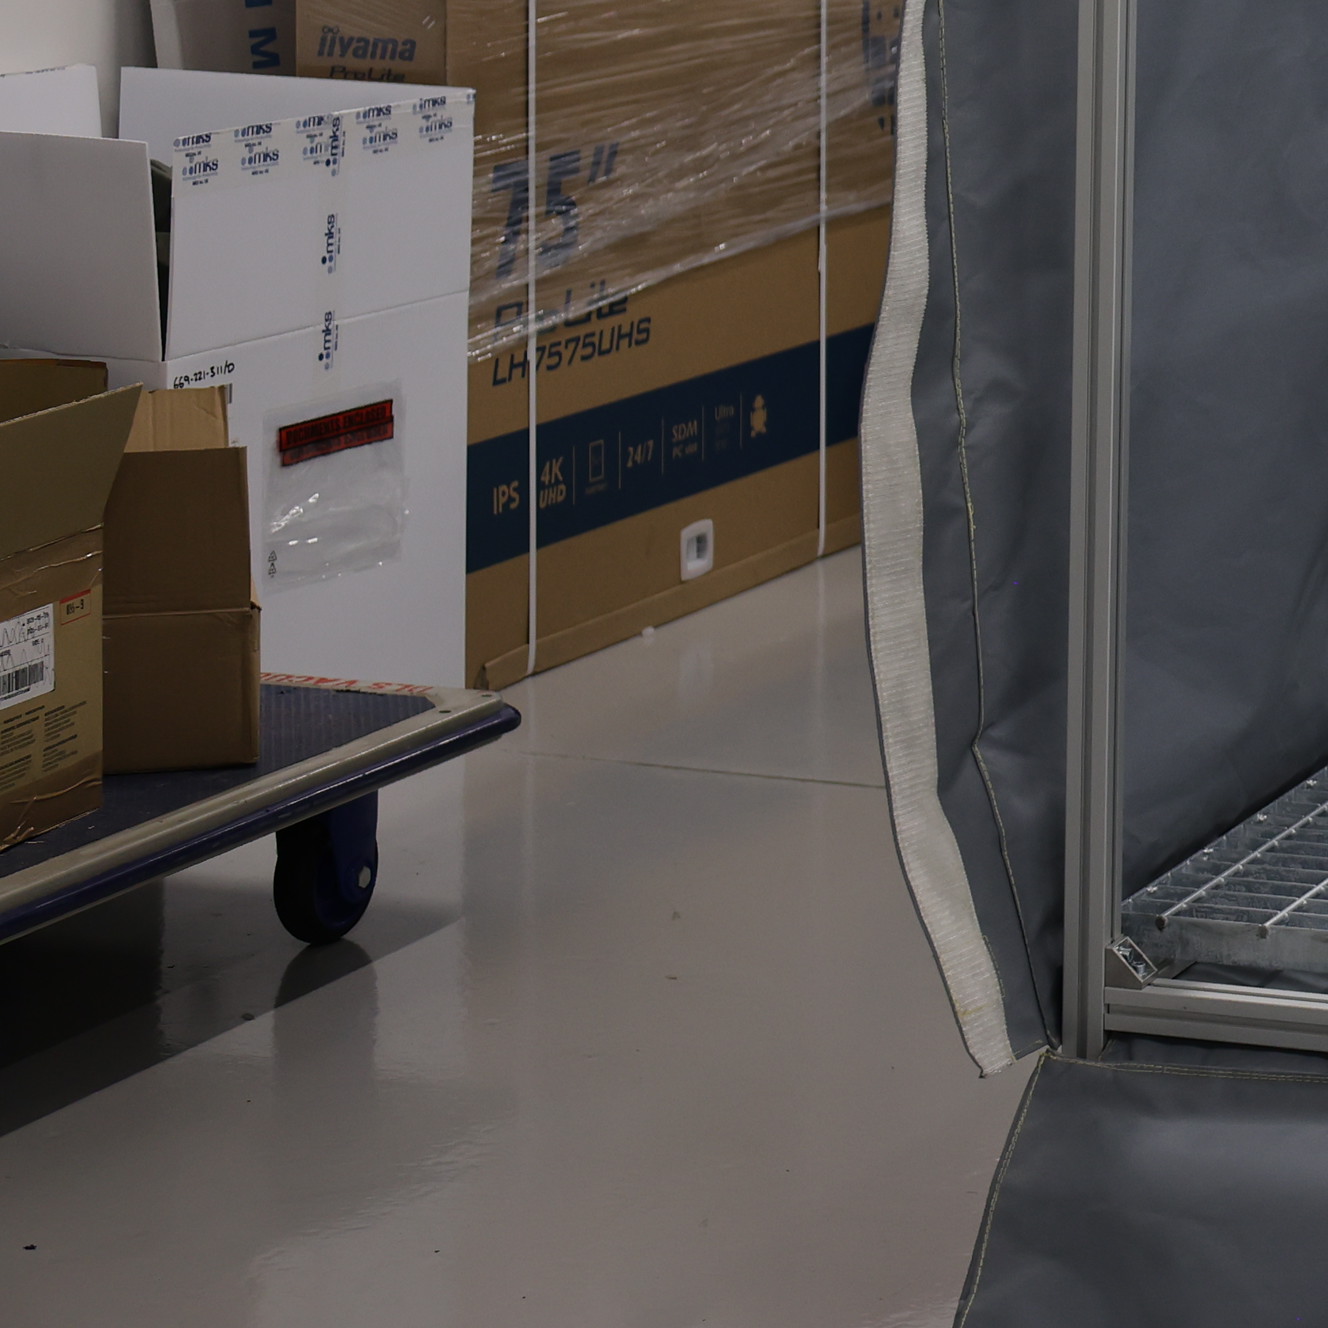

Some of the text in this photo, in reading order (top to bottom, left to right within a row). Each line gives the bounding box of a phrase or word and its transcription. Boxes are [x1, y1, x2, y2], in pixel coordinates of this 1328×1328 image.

[316, 25, 417, 63] iiyama
[491, 316, 652, 387] LH7575UHS
[671, 419, 698, 443] SDM
[626, 439, 655, 469] 24/7
[539, 455, 564, 485] 4K
[492, 480, 521, 516] IPS
[539, 483, 567, 510] UHD
